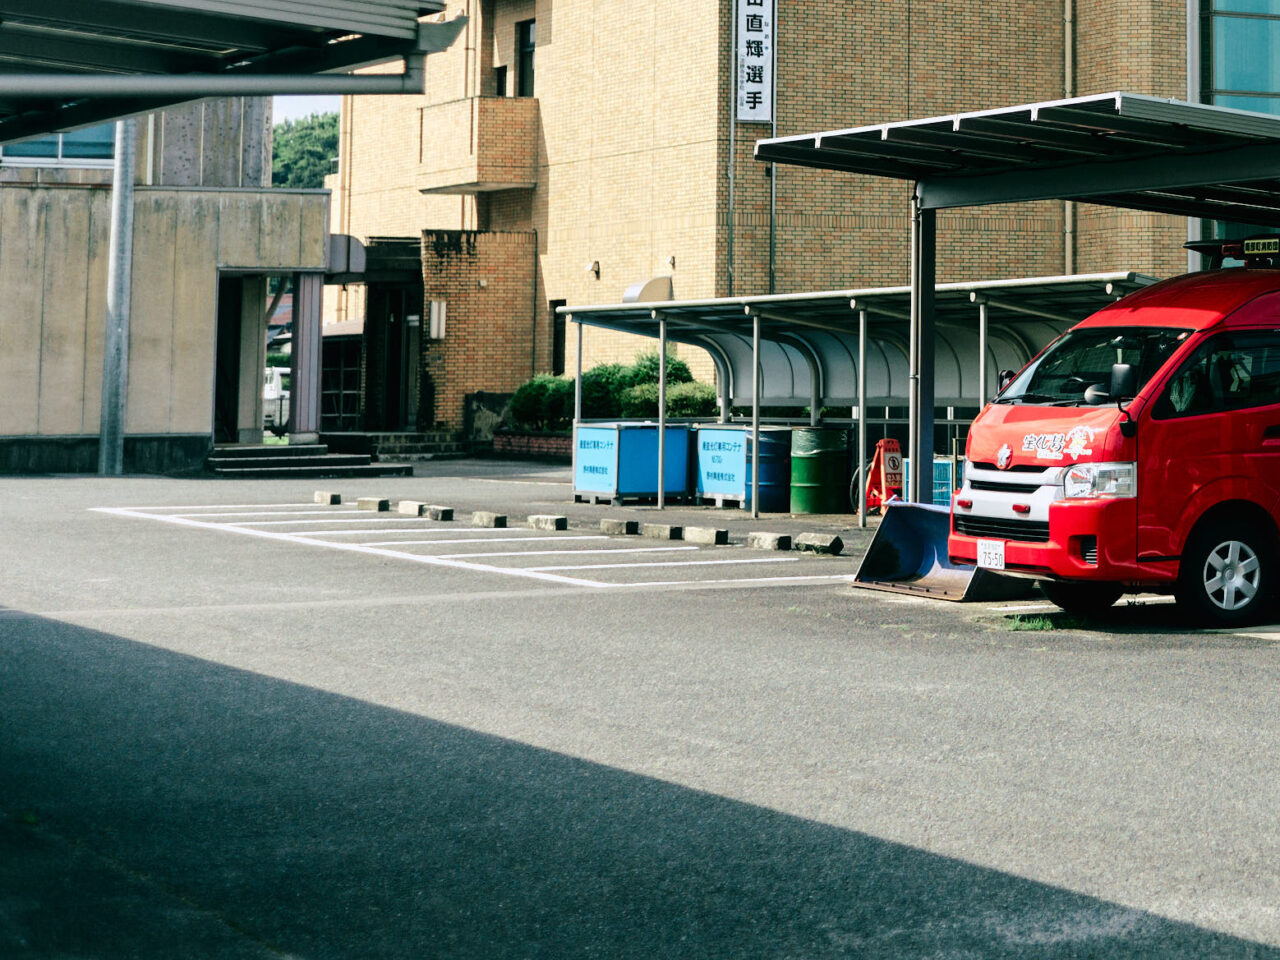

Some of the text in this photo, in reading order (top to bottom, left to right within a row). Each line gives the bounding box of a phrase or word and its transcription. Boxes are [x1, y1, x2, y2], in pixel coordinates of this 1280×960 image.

[1024, 435, 1064, 451] 宝くじ号
[983, 551, 1004, 567] 75-50
